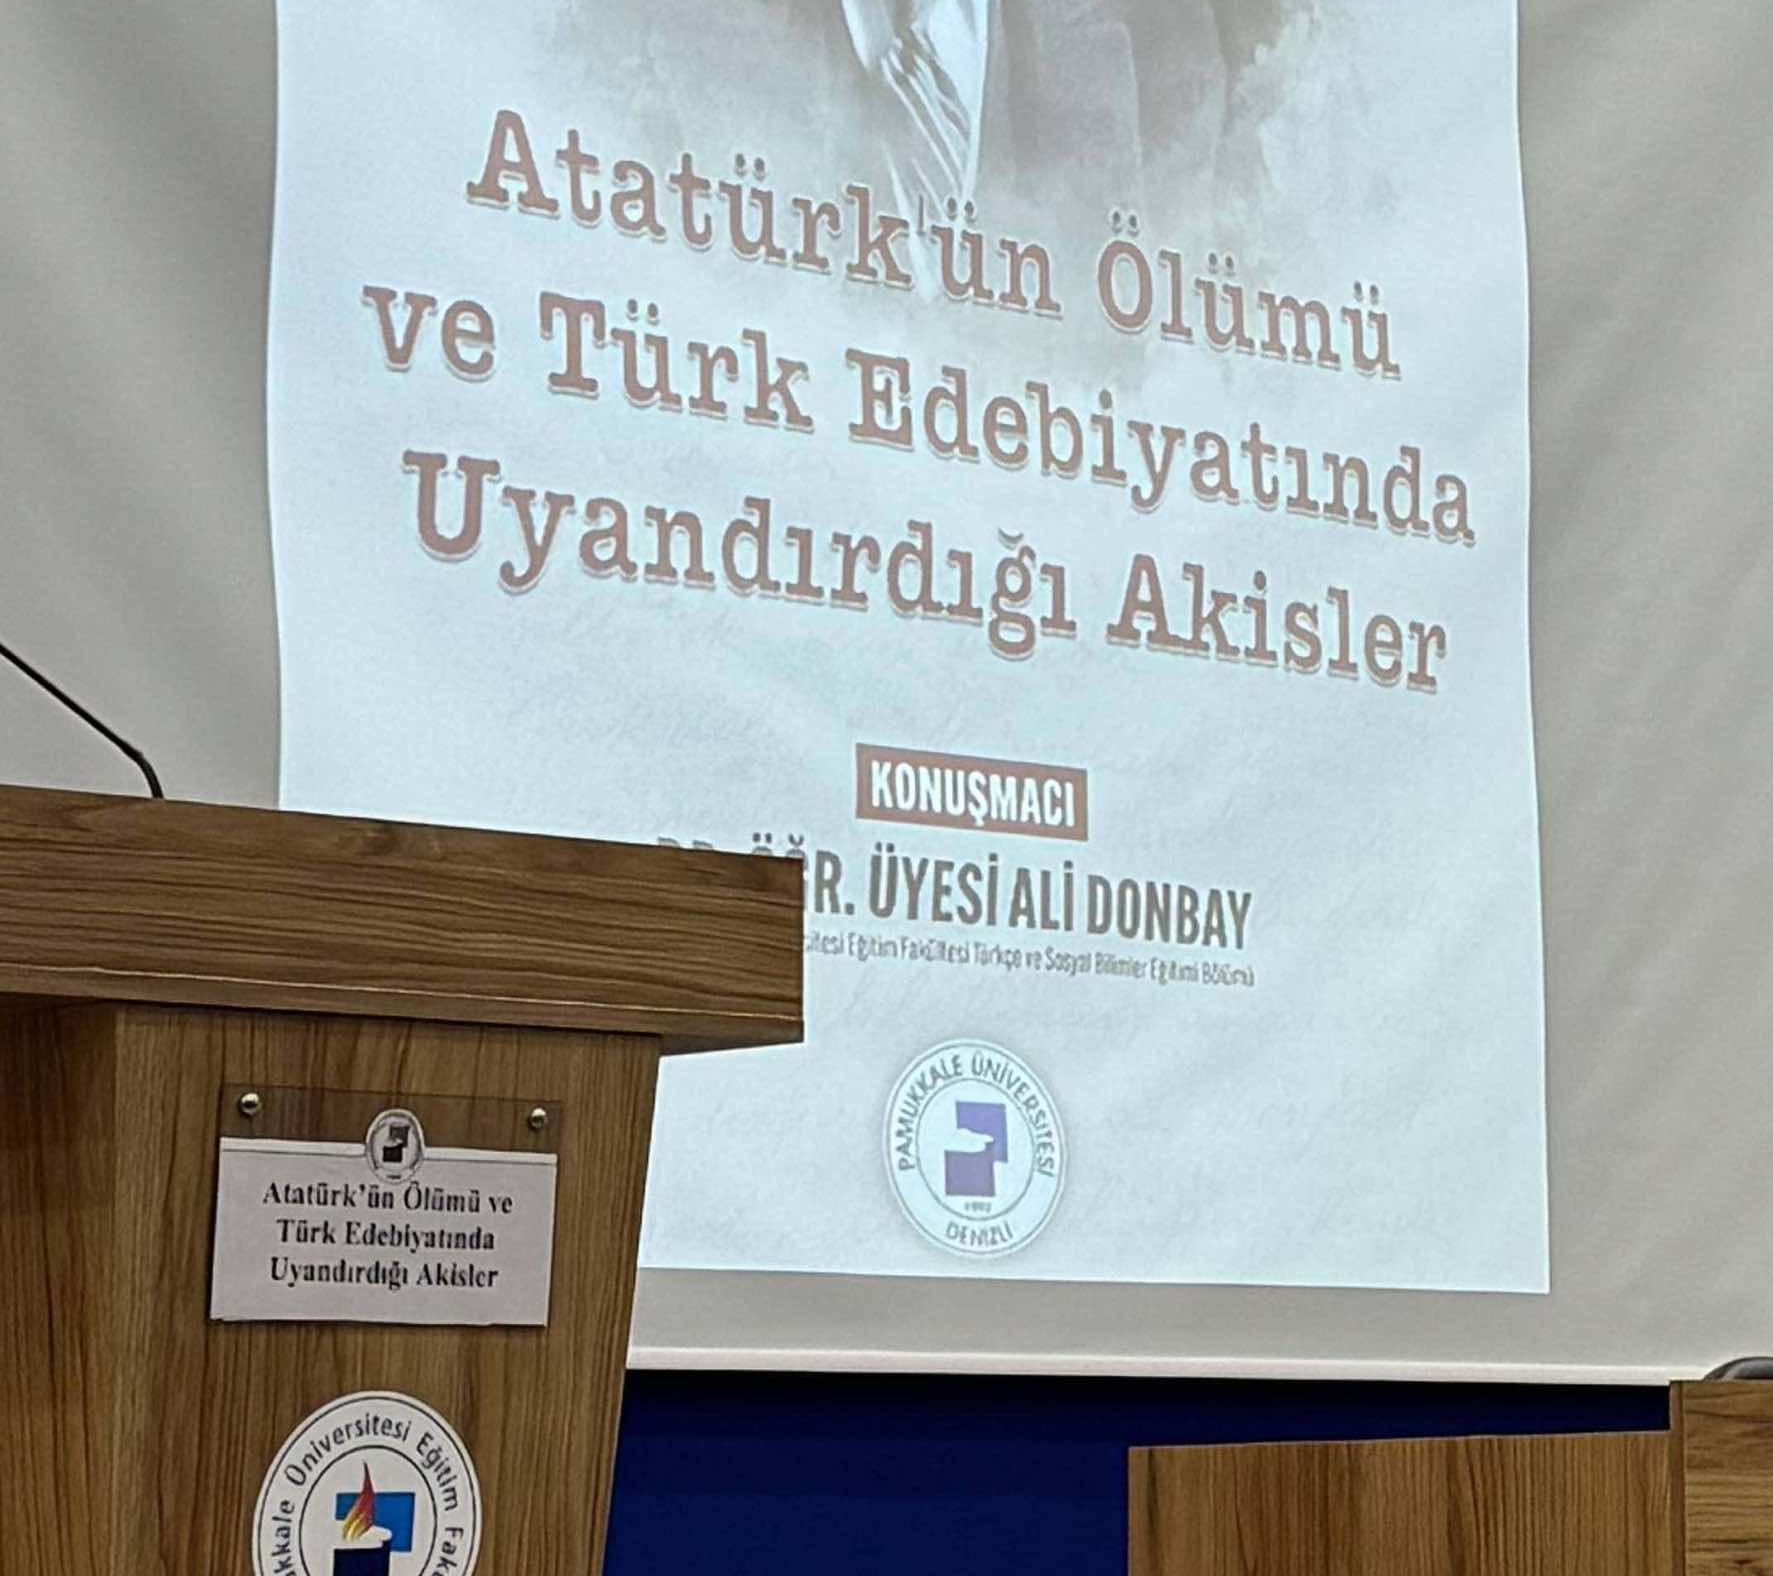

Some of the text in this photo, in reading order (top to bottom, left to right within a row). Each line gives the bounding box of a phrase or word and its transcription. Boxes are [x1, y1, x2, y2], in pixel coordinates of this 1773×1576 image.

[465, 108, 1401, 379] Atatürk'ün Ölümü
[363, 284, 1476, 547] ve Türk Edebiyatında
[404, 450, 1447, 692] Uyandırdığı Akisler
[871, 761, 1075, 827] KONUŞMACI
[869, 842, 998, 927] ÜYESİ
[1008, 861, 1075, 932] ALİ
[1086, 874, 1253, 950] DONBAY
[848, 933, 898, 961] Eğitim
[1025, 948, 1043, 968] ve
[1046, 947, 1091, 977] Sosyal
[895, 1054, 962, 1171] PAMUKKALE
[276, 1219, 494, 1253] Türk Edebiyatında
[403, 1181, 481, 1214] Ölümü
[489, 1195, 513, 1214] ve
[270, 1257, 499, 1289] Uyandırdığı Akisler
[416, 1431, 458, 1512] Eğitim
